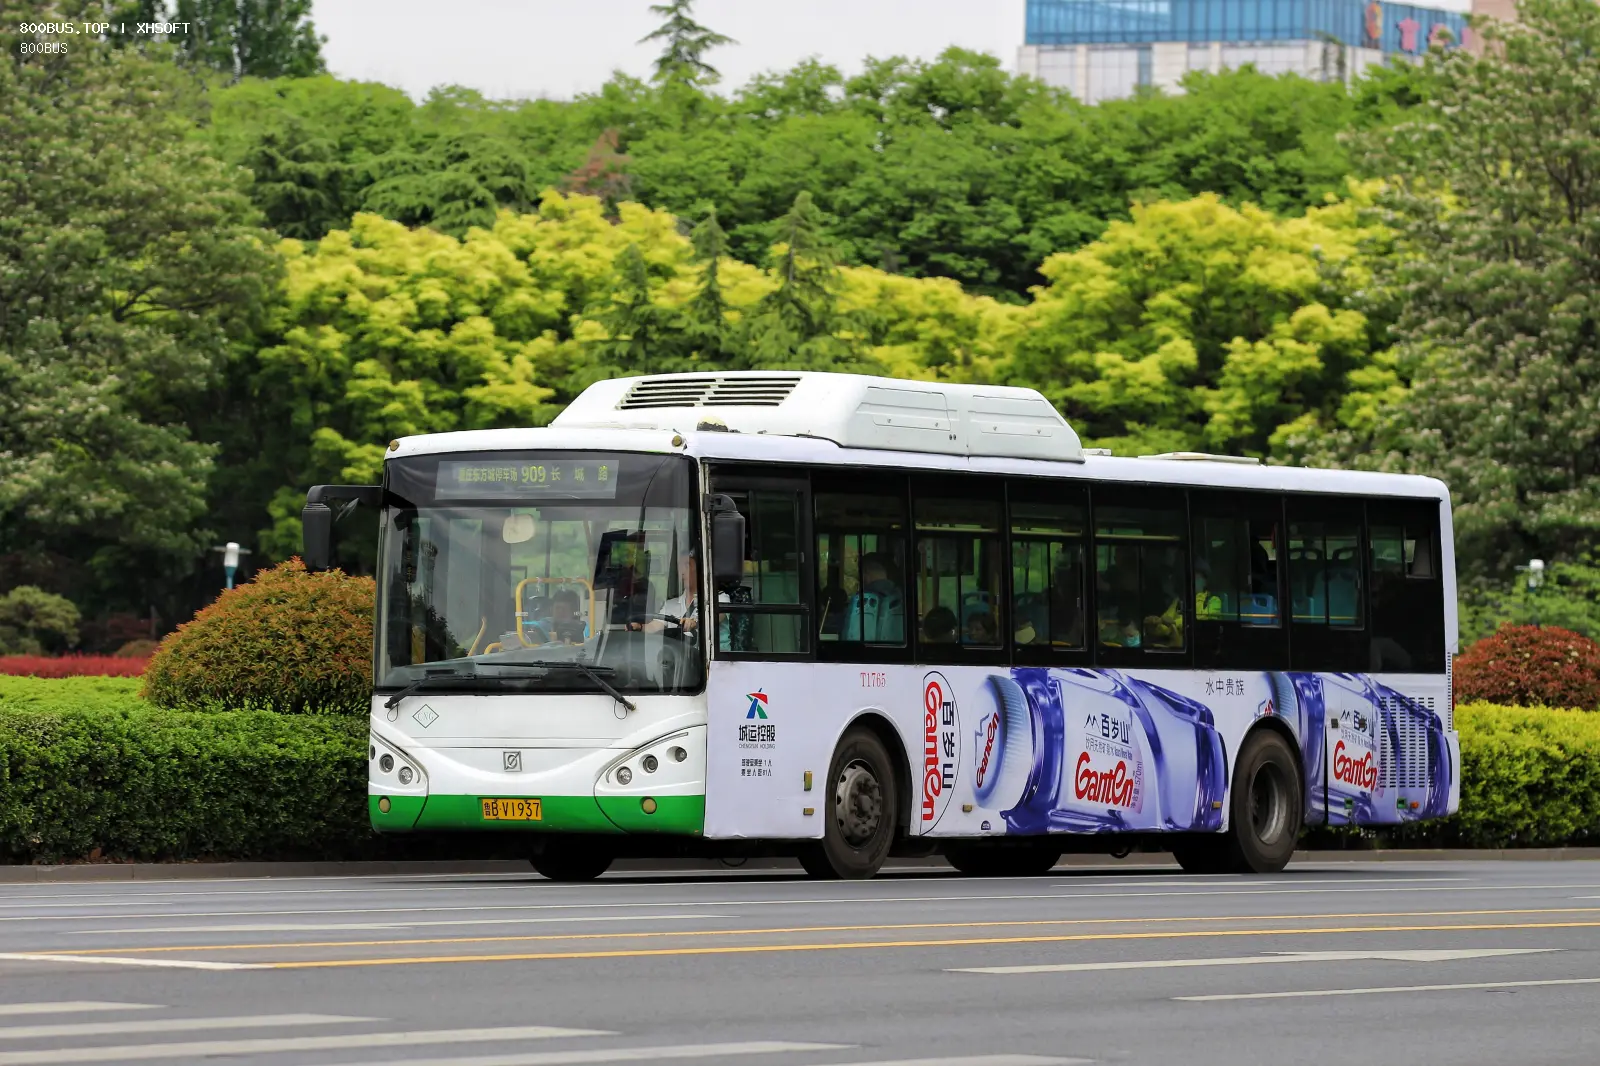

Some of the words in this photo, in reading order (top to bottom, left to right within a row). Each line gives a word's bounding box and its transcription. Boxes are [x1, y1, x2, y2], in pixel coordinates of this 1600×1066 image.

[521, 465, 546, 483] 909
[860, 672, 886, 688] T1765
[1205, 677, 1245, 696] 水中贵族
[417, 711, 434, 722] CNG
[738, 724, 776, 742] 城运控股
[1101, 713, 1130, 744] 百岁山
[942, 701, 954, 789] 百岁山
